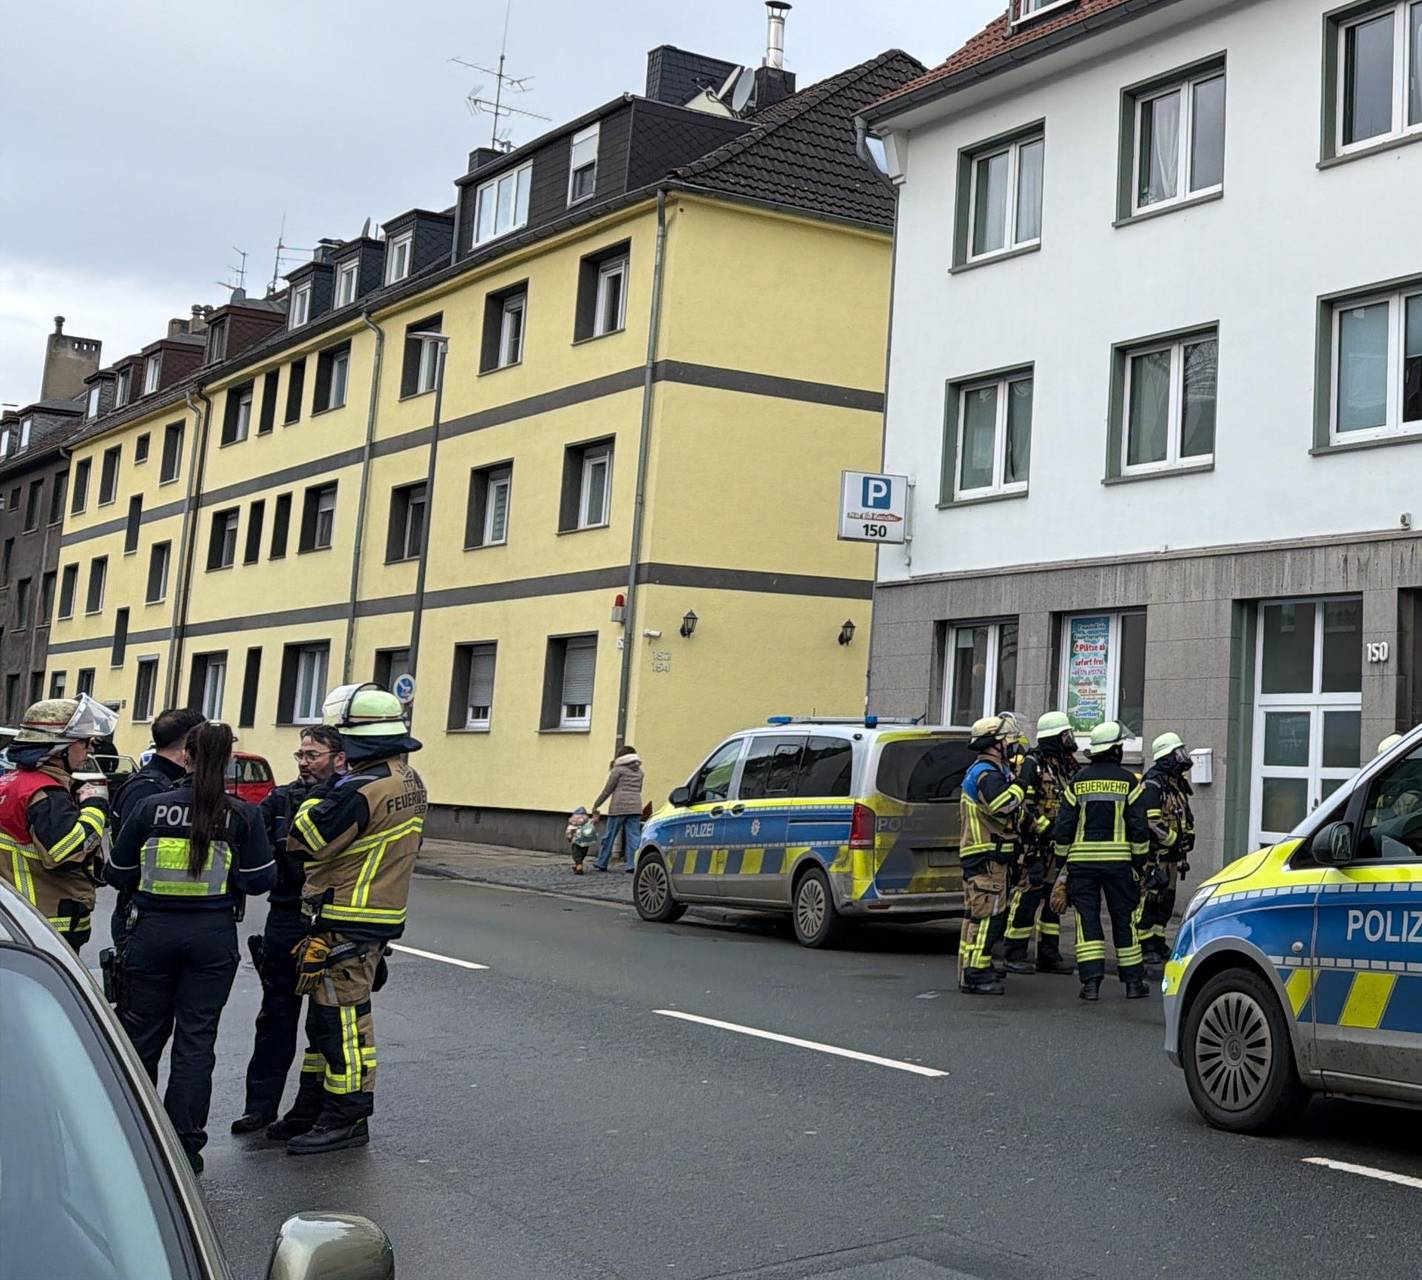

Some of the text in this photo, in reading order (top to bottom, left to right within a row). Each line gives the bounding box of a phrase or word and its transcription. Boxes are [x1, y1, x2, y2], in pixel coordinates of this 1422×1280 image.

[867, 479, 888, 507] P
[862, 523, 887, 538] 150
[1366, 641, 1388, 662] 150
[1075, 781, 1128, 794] FEUERWEHR
[386, 790, 427, 814] FEUERWE
[153, 805, 233, 829] POLI
[685, 823, 715, 838] POLIZEI
